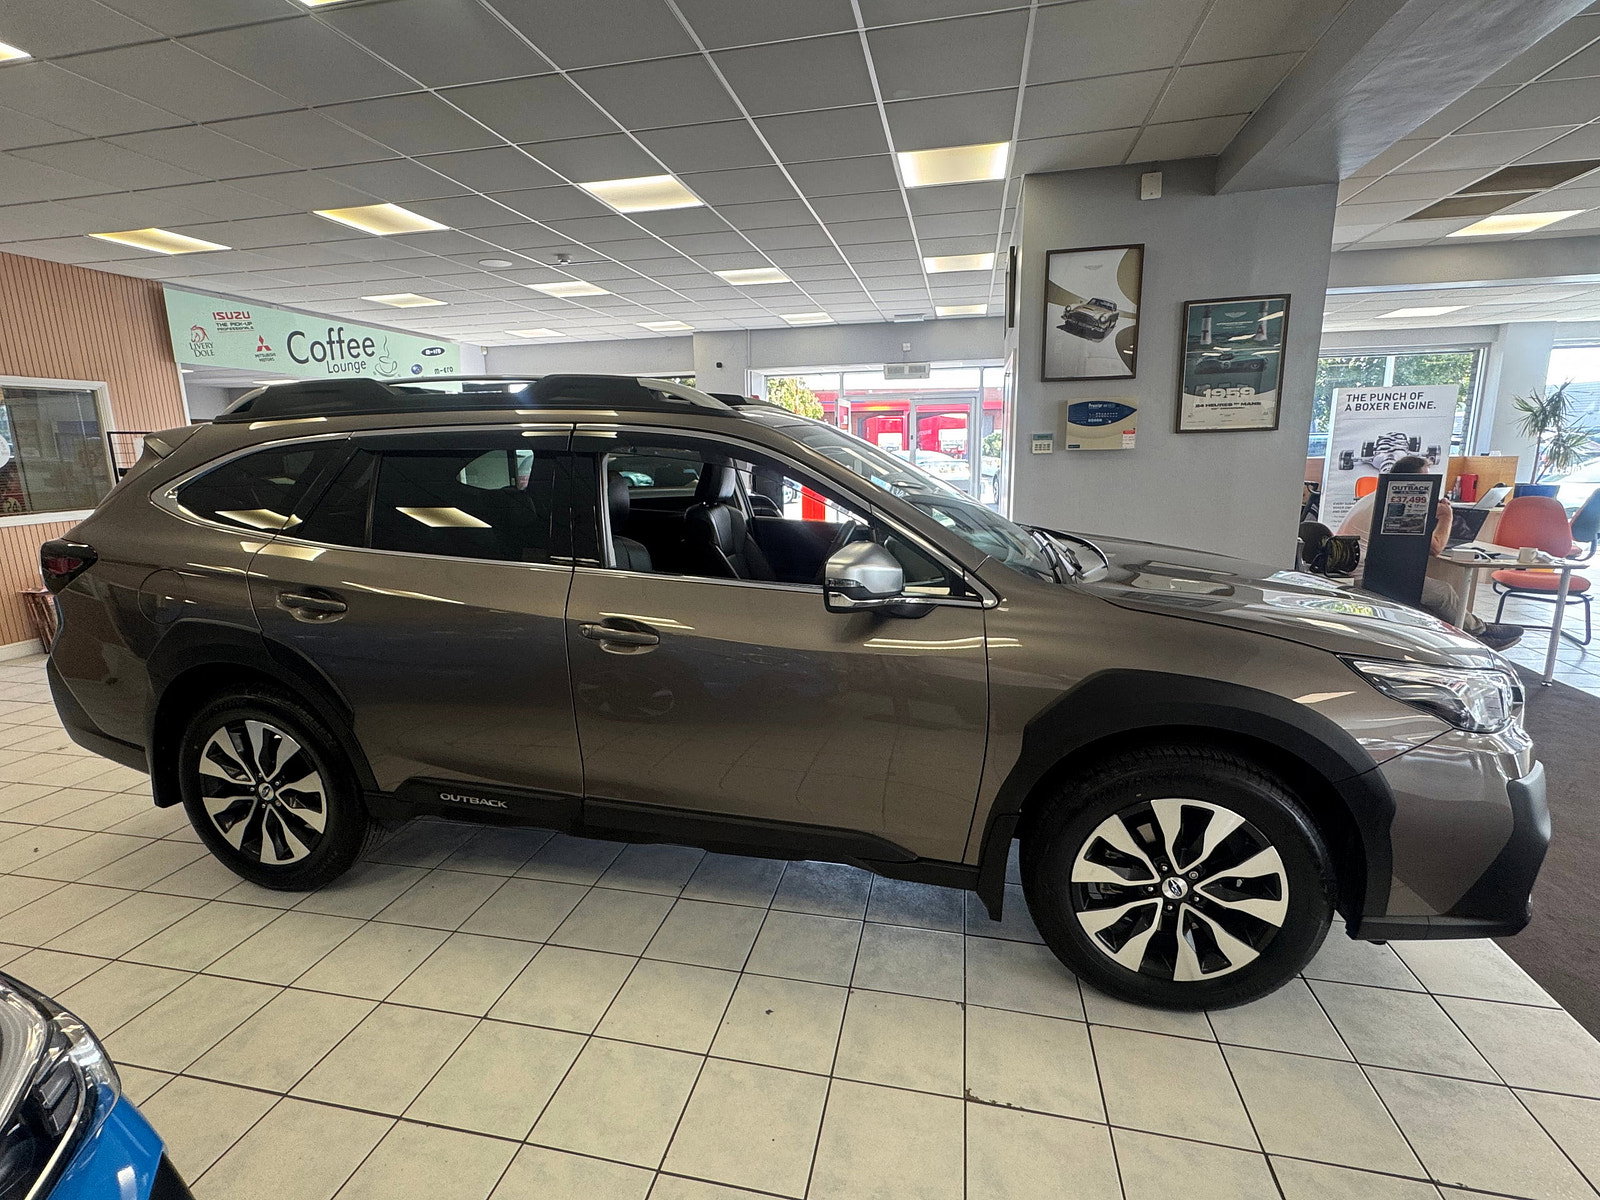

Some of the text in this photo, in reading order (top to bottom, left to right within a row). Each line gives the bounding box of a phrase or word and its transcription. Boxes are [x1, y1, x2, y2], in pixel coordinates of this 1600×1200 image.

[212, 311, 251, 320] ISUZU
[189, 342, 214, 351] LIVERY
[287, 327, 375, 364] Coffee
[194, 349, 215, 357] DOLE
[326, 360, 366, 374] Lounge
[1203, 386, 1256, 398] 1959
[1346, 392, 1424, 402] THE PUNCH OF
[1355, 402, 1389, 411] BOXER
[1393, 401, 1437, 410] ENGINE.
[440, 793, 508, 809] OUTBACK
